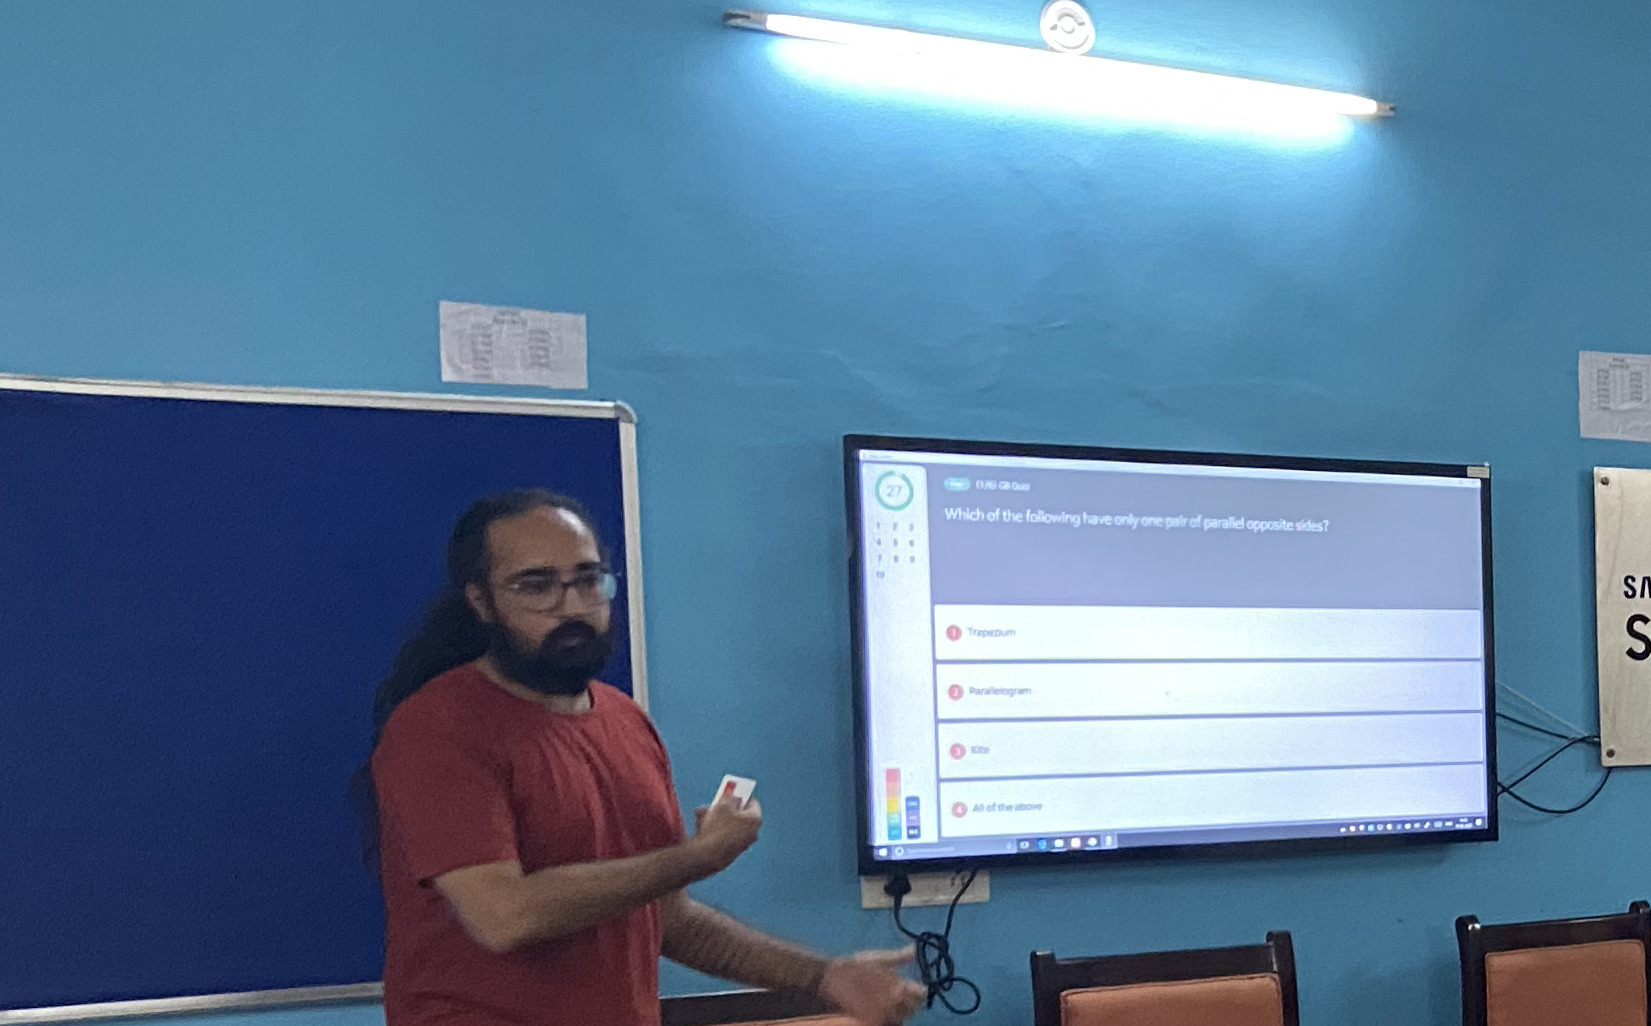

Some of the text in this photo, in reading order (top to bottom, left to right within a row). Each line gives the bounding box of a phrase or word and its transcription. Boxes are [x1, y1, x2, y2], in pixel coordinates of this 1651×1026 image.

[887, 485, 902, 498] 27
[945, 507, 1330, 533] Which of the following have only one pair of parallel opposite sides?
[969, 686, 1032, 698] Parallelogram
[986, 802, 997, 812] of
[998, 803, 1014, 812] the
[1015, 803, 1043, 812] above
